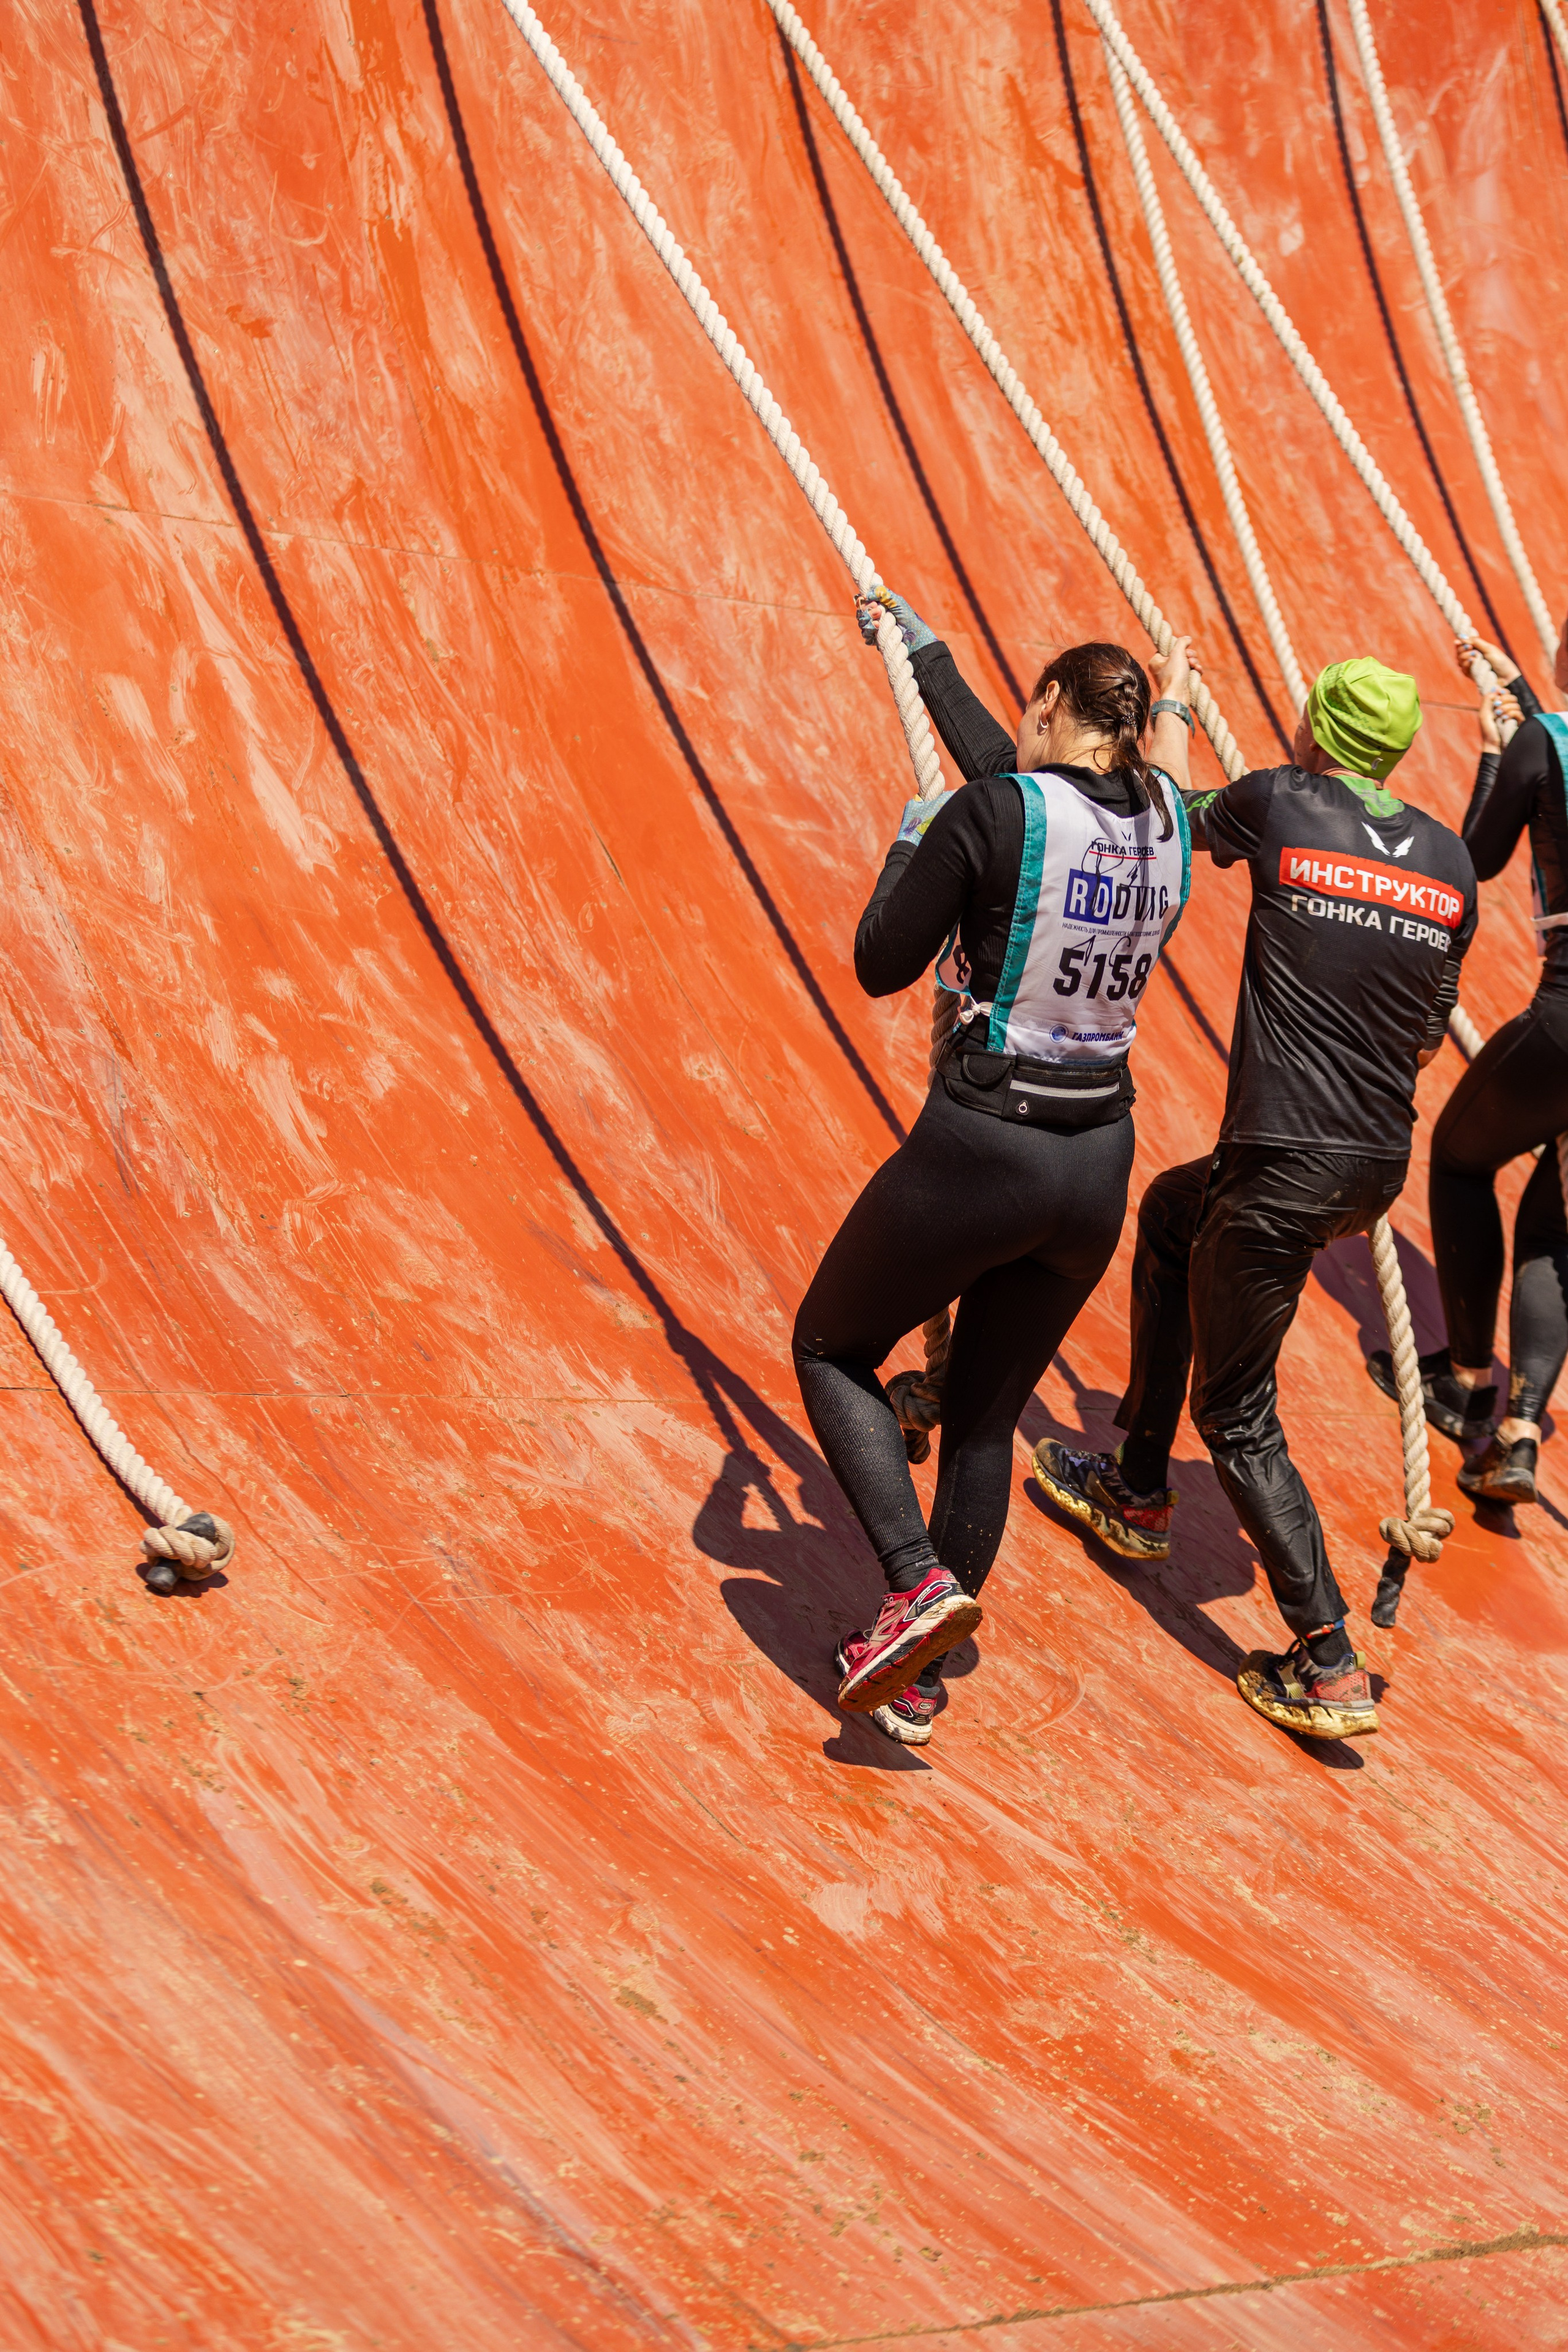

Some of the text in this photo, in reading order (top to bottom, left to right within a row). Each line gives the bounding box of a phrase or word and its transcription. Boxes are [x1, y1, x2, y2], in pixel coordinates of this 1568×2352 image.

[1090, 841, 1154, 856] ГОНКА ГЕРОЕВ
[1069, 877, 1169, 921] RODVIG
[1290, 858, 1460, 919] ИНСТРУКТОР
[1291, 894, 1382, 930] ГОНКА
[1053, 948, 1152, 1001] 5158
[1072, 1031, 1124, 1042] ГАЗПРОМБАНК
